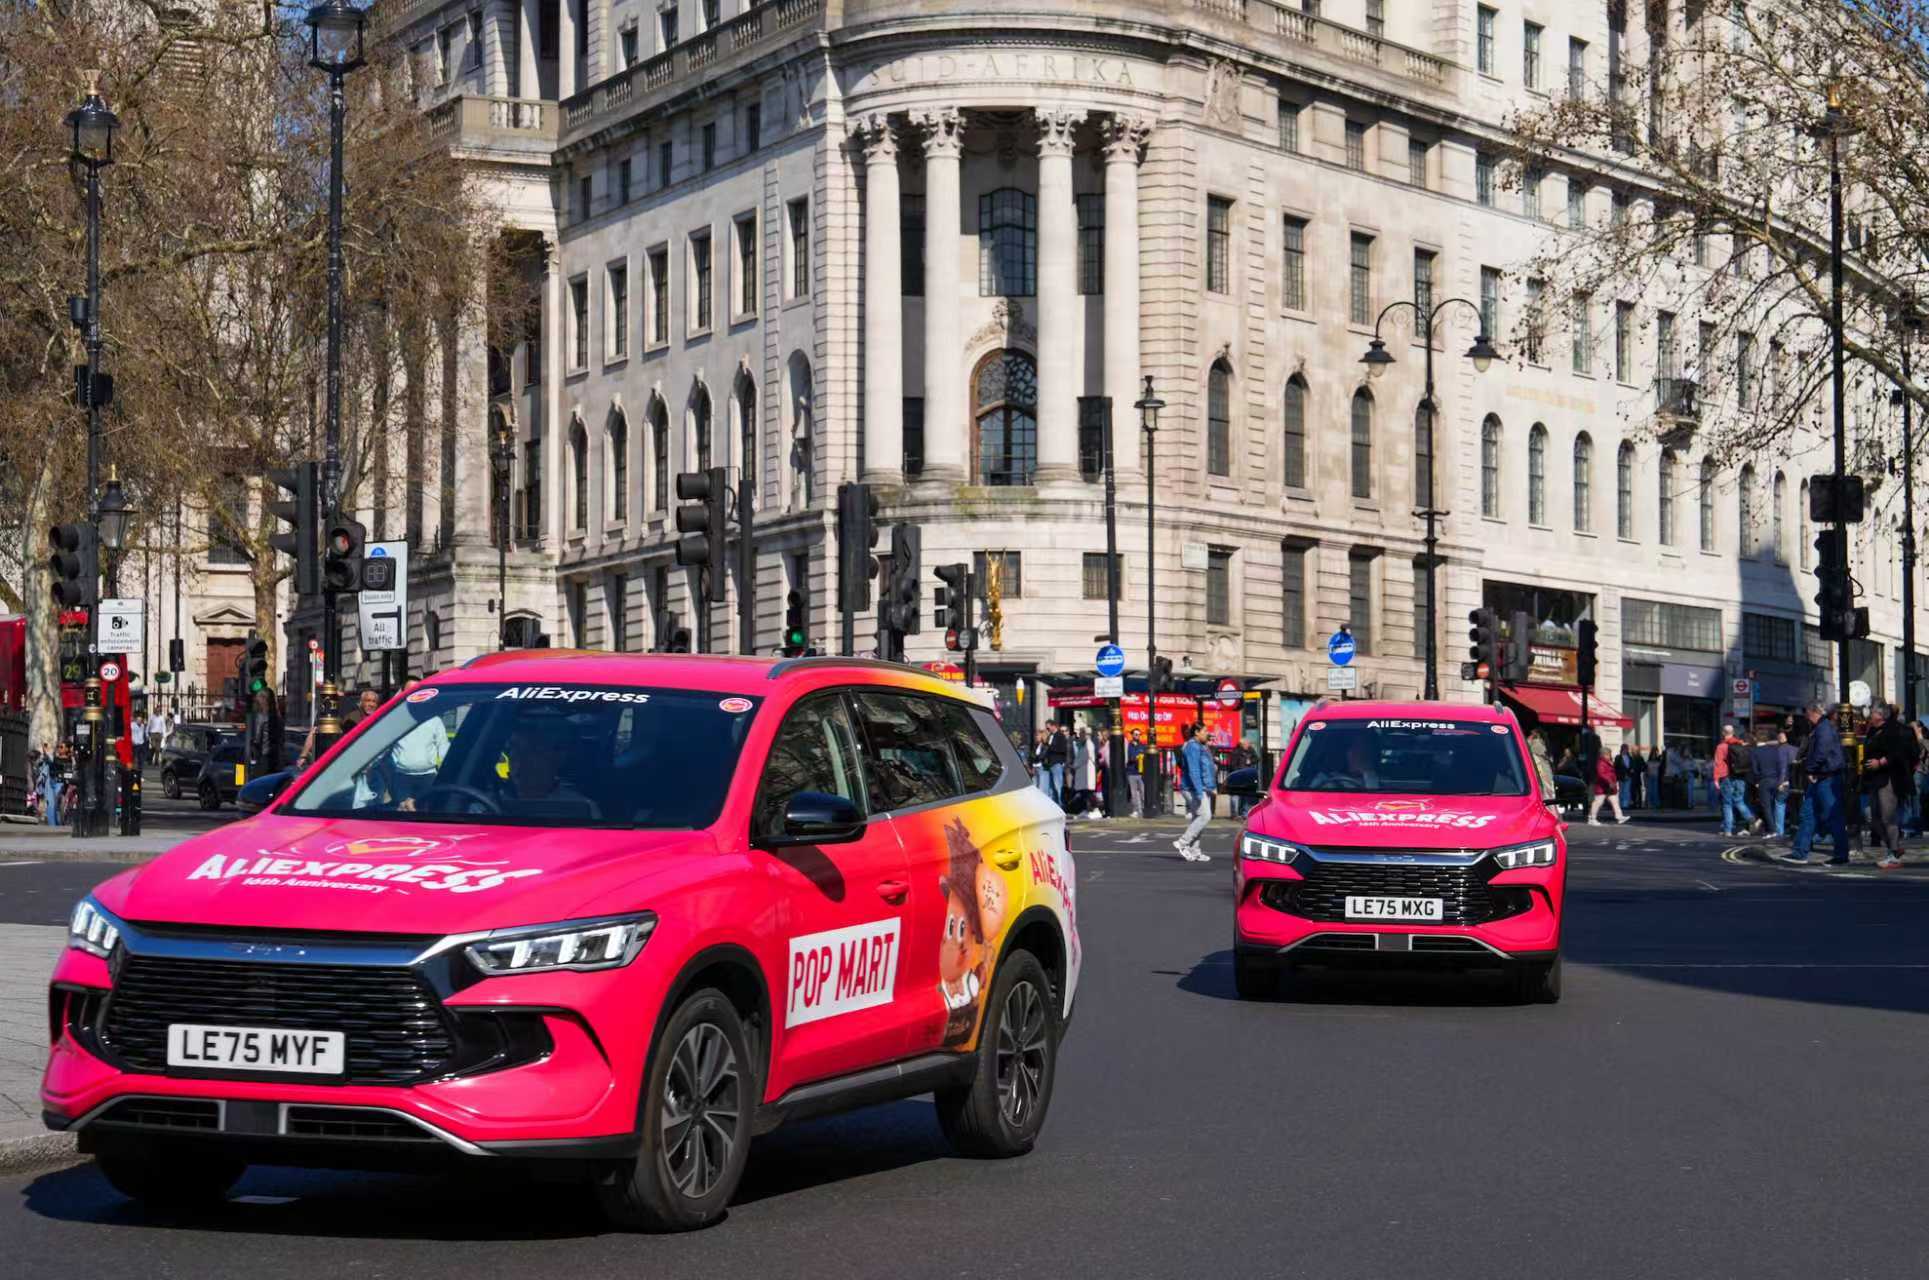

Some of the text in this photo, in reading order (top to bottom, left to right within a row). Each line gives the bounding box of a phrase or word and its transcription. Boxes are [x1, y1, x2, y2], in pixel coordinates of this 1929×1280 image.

[870, 54, 1136, 86] SUID-AFRIKA
[374, 623, 385, 632] All
[368, 635, 393, 645] traffic
[103, 668, 117, 676] 20
[495, 687, 651, 703] AliExpress
[1366, 720, 1456, 730] AliExpress
[281, 877, 390, 894] Anniversary
[1352, 898, 1435, 916] LE75 MXG
[790, 932, 895, 1013] POP MART
[182, 1029, 330, 1067] LE75 MYF
